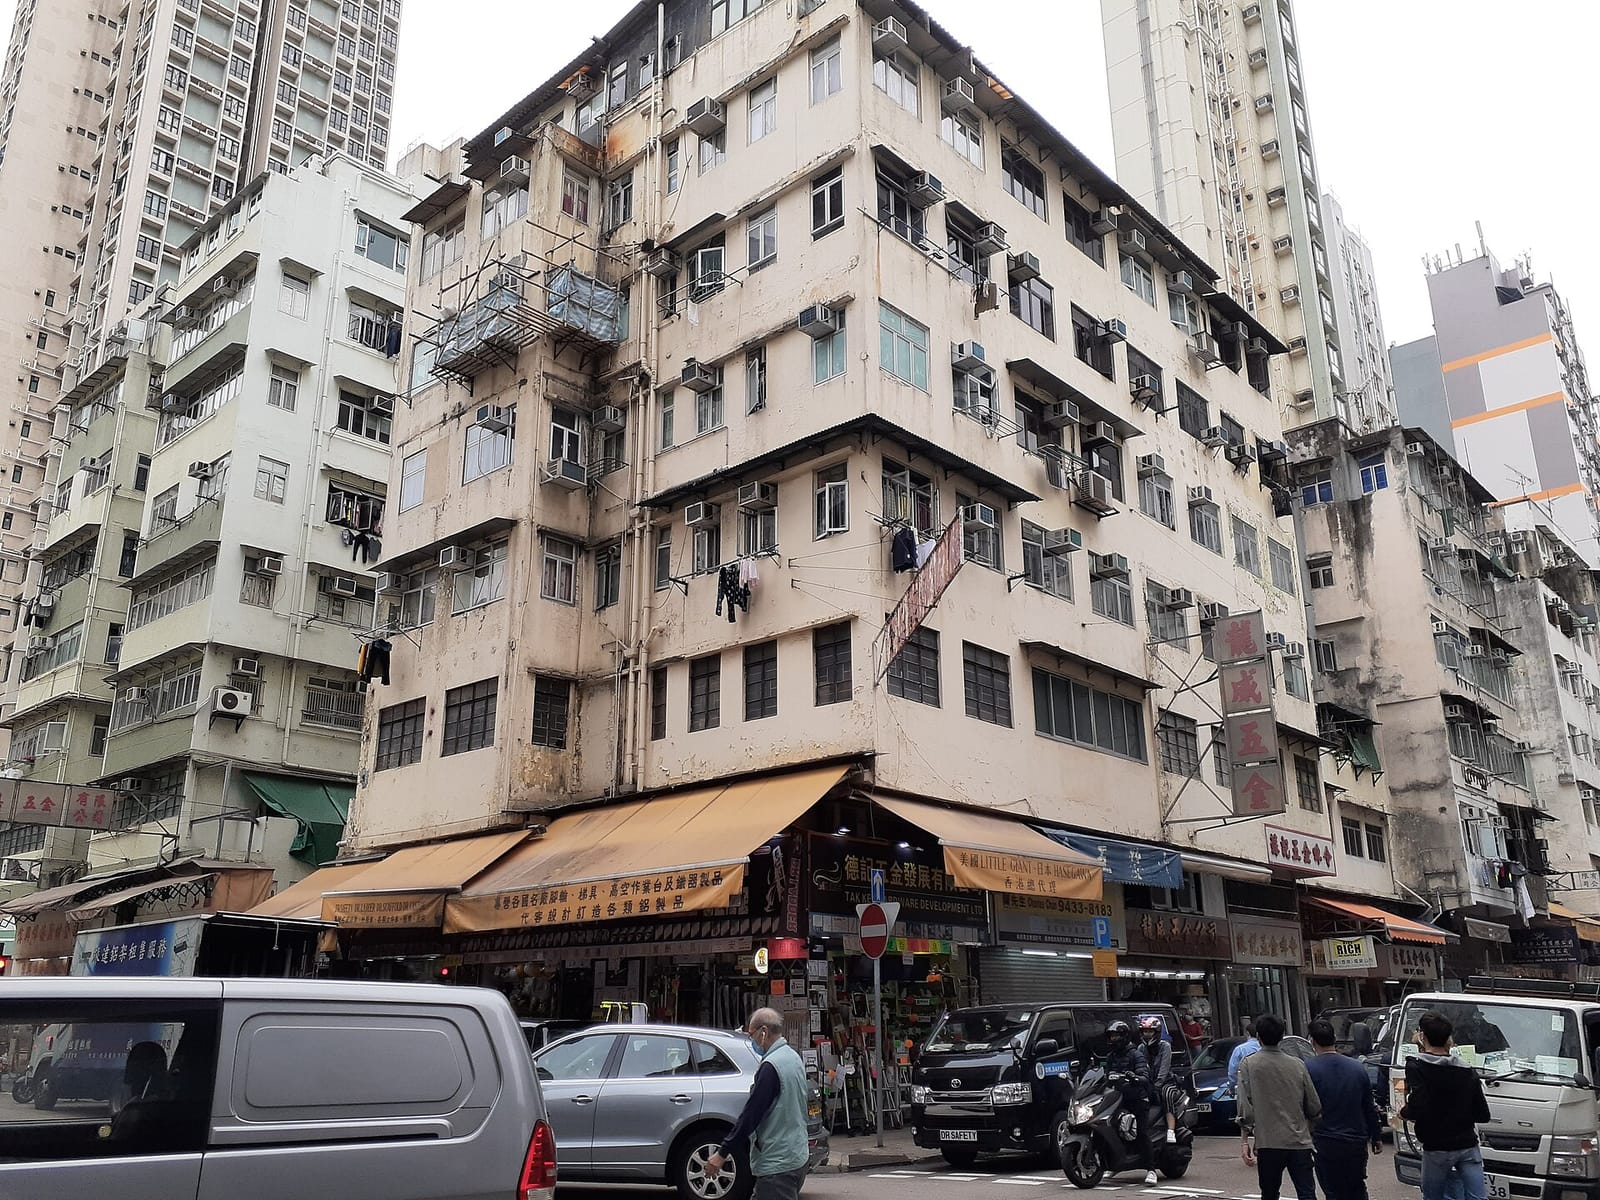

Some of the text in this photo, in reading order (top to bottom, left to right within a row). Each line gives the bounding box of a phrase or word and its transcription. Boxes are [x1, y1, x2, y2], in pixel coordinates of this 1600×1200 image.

[22, 795, 56, 812] 五金
[980, 852, 1007, 872] LITTLE
[920, 899, 971, 915] DEVELOPMENT
[1058, 900, 1113, 917] 9433-8183
[1096, 919, 1107, 945] P
[1337, 943, 1361, 955] RICH
